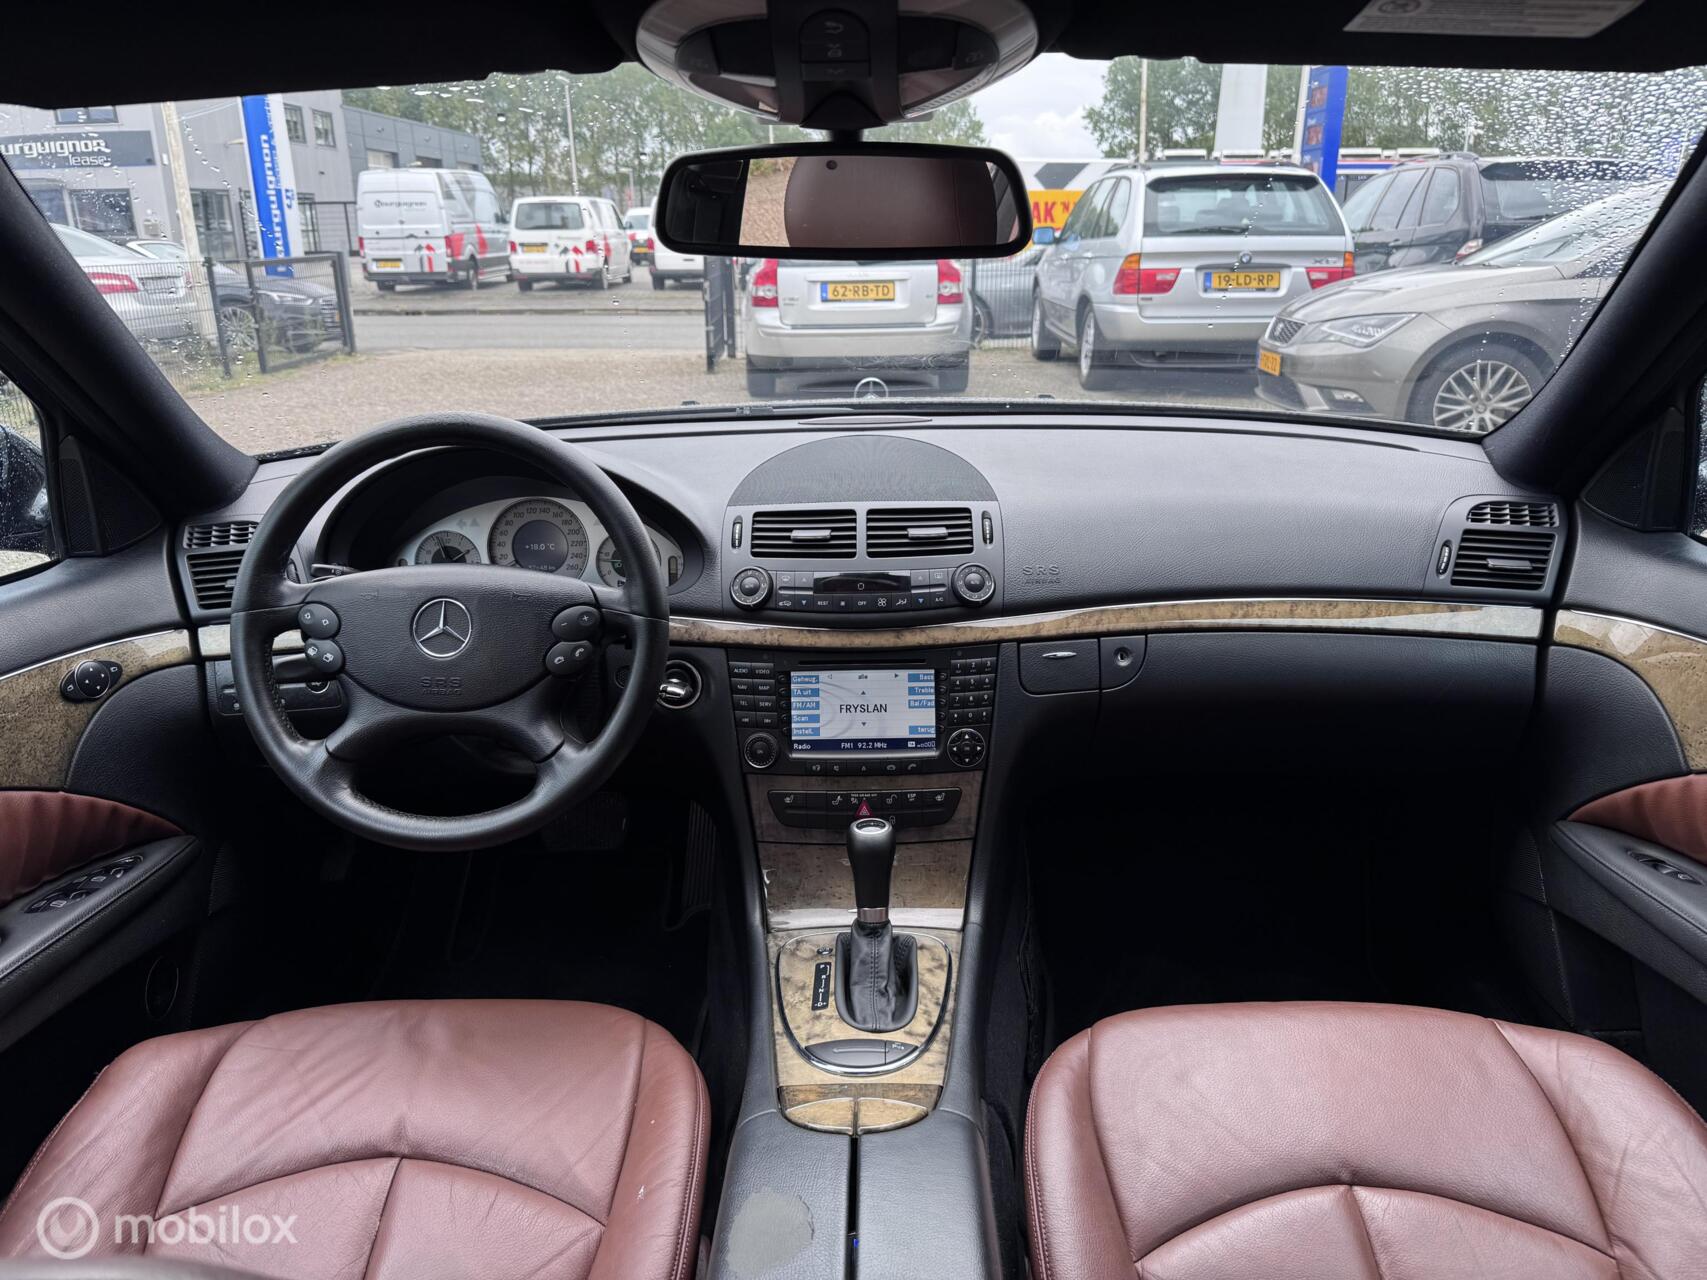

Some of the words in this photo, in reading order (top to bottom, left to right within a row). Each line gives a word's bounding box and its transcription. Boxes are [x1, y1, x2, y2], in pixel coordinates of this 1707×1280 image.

[69, 154, 107, 167] lease
[1217, 274, 1274, 286] 19-LD-RP
[831, 285, 890, 298] 62-RB-TD
[839, 703, 887, 713] FRYSLAN
